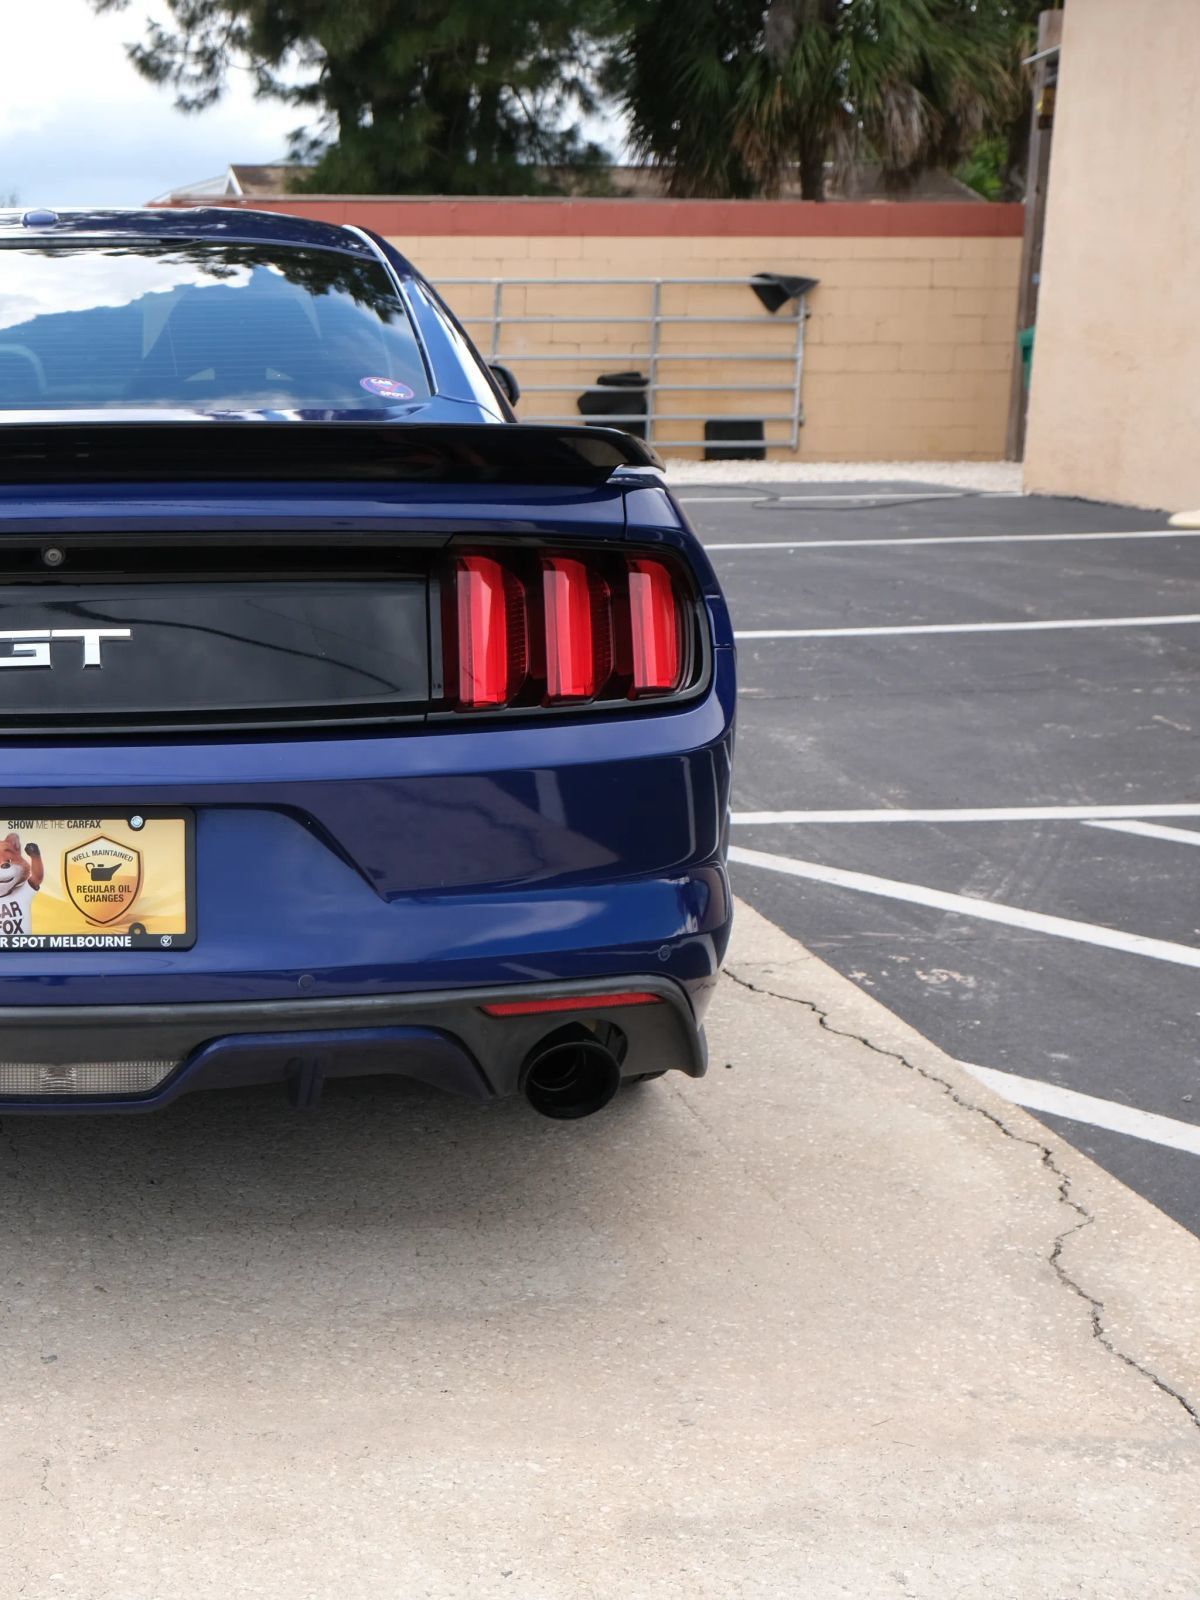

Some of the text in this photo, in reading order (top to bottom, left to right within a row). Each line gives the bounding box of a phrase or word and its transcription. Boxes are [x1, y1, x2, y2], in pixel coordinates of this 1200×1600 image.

[7, 820, 101, 830] SHOW ME THE CARFAX
[72, 849, 134, 862] WELL MAINTAINED
[76, 884, 132, 894] REGULAR OIL
[84, 894, 124, 903] CHANGES
[11, 937, 46, 948] SPOT
[50, 936, 132, 947] MELBOURNE
